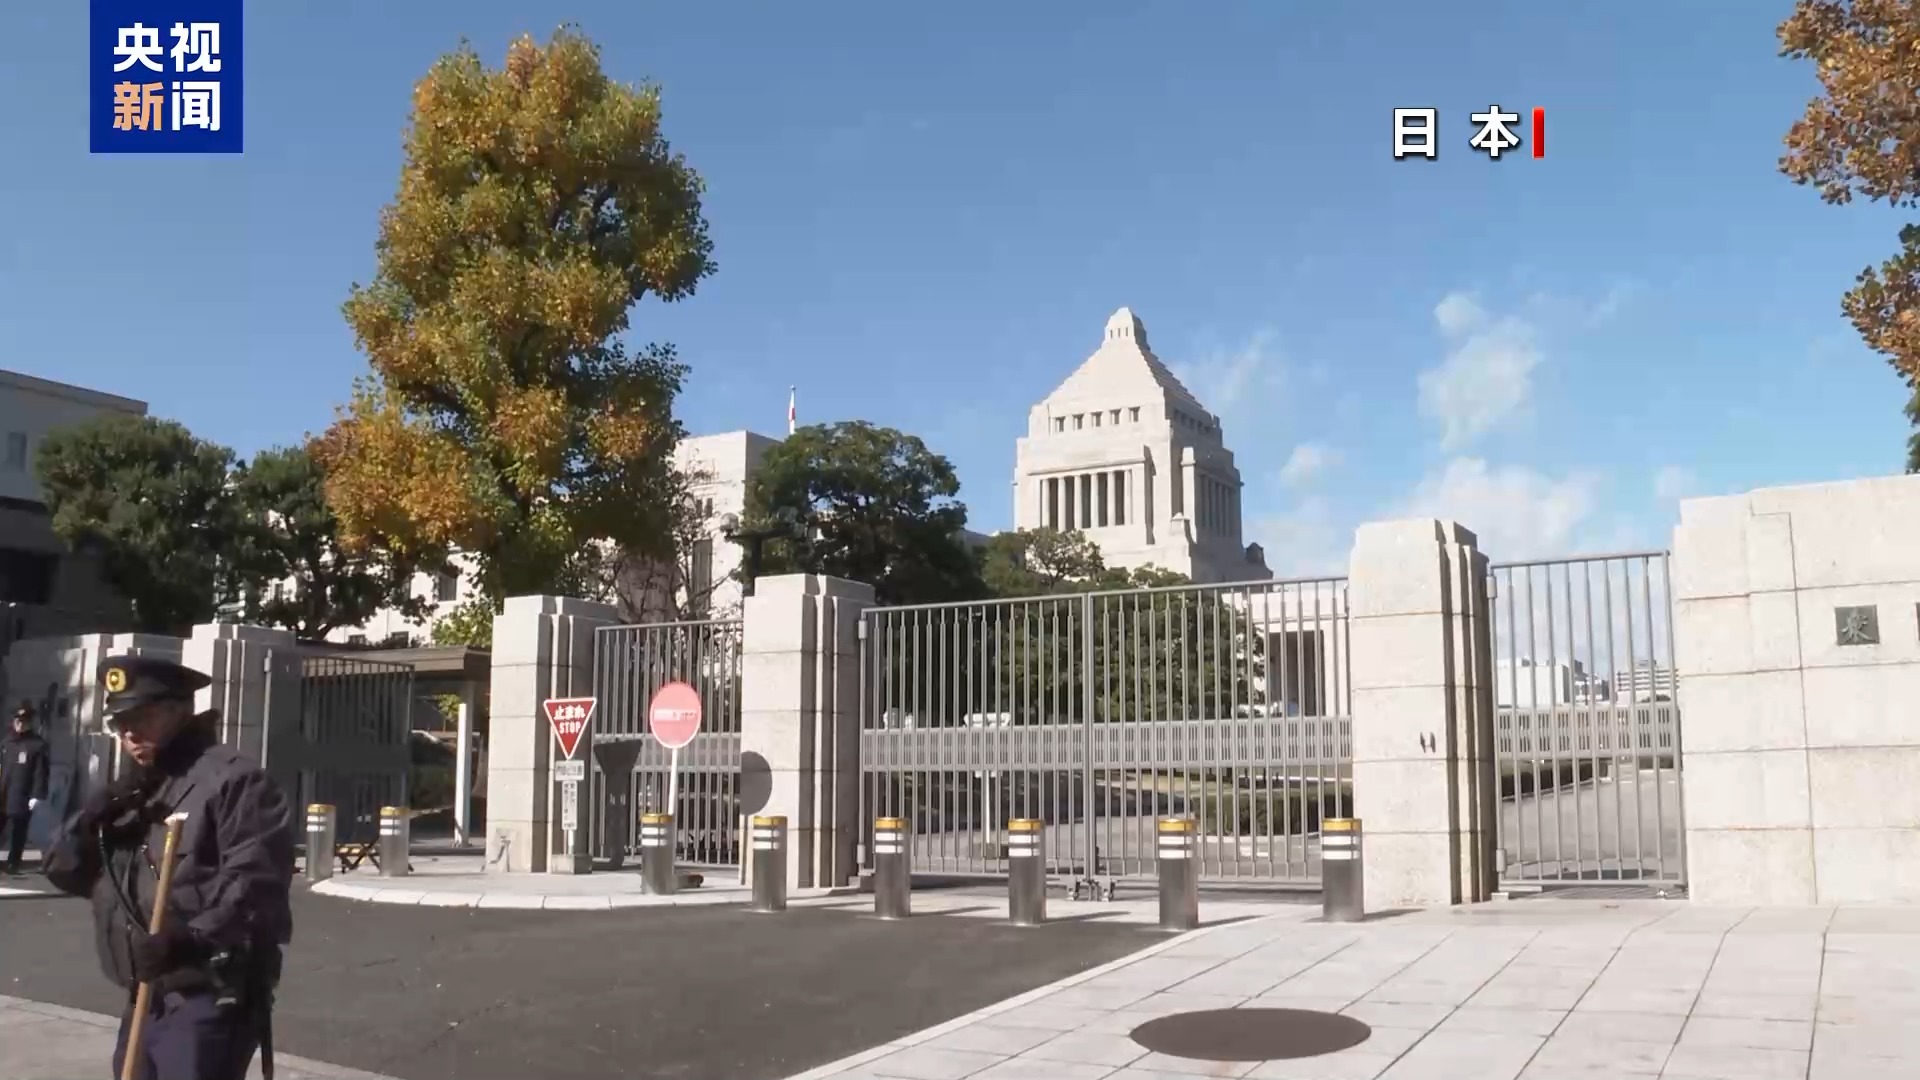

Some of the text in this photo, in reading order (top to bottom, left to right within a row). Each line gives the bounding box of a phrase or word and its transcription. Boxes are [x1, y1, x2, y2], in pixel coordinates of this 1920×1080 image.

[553, 704, 586, 720] 止まれ
[559, 721, 581, 735] STOP
